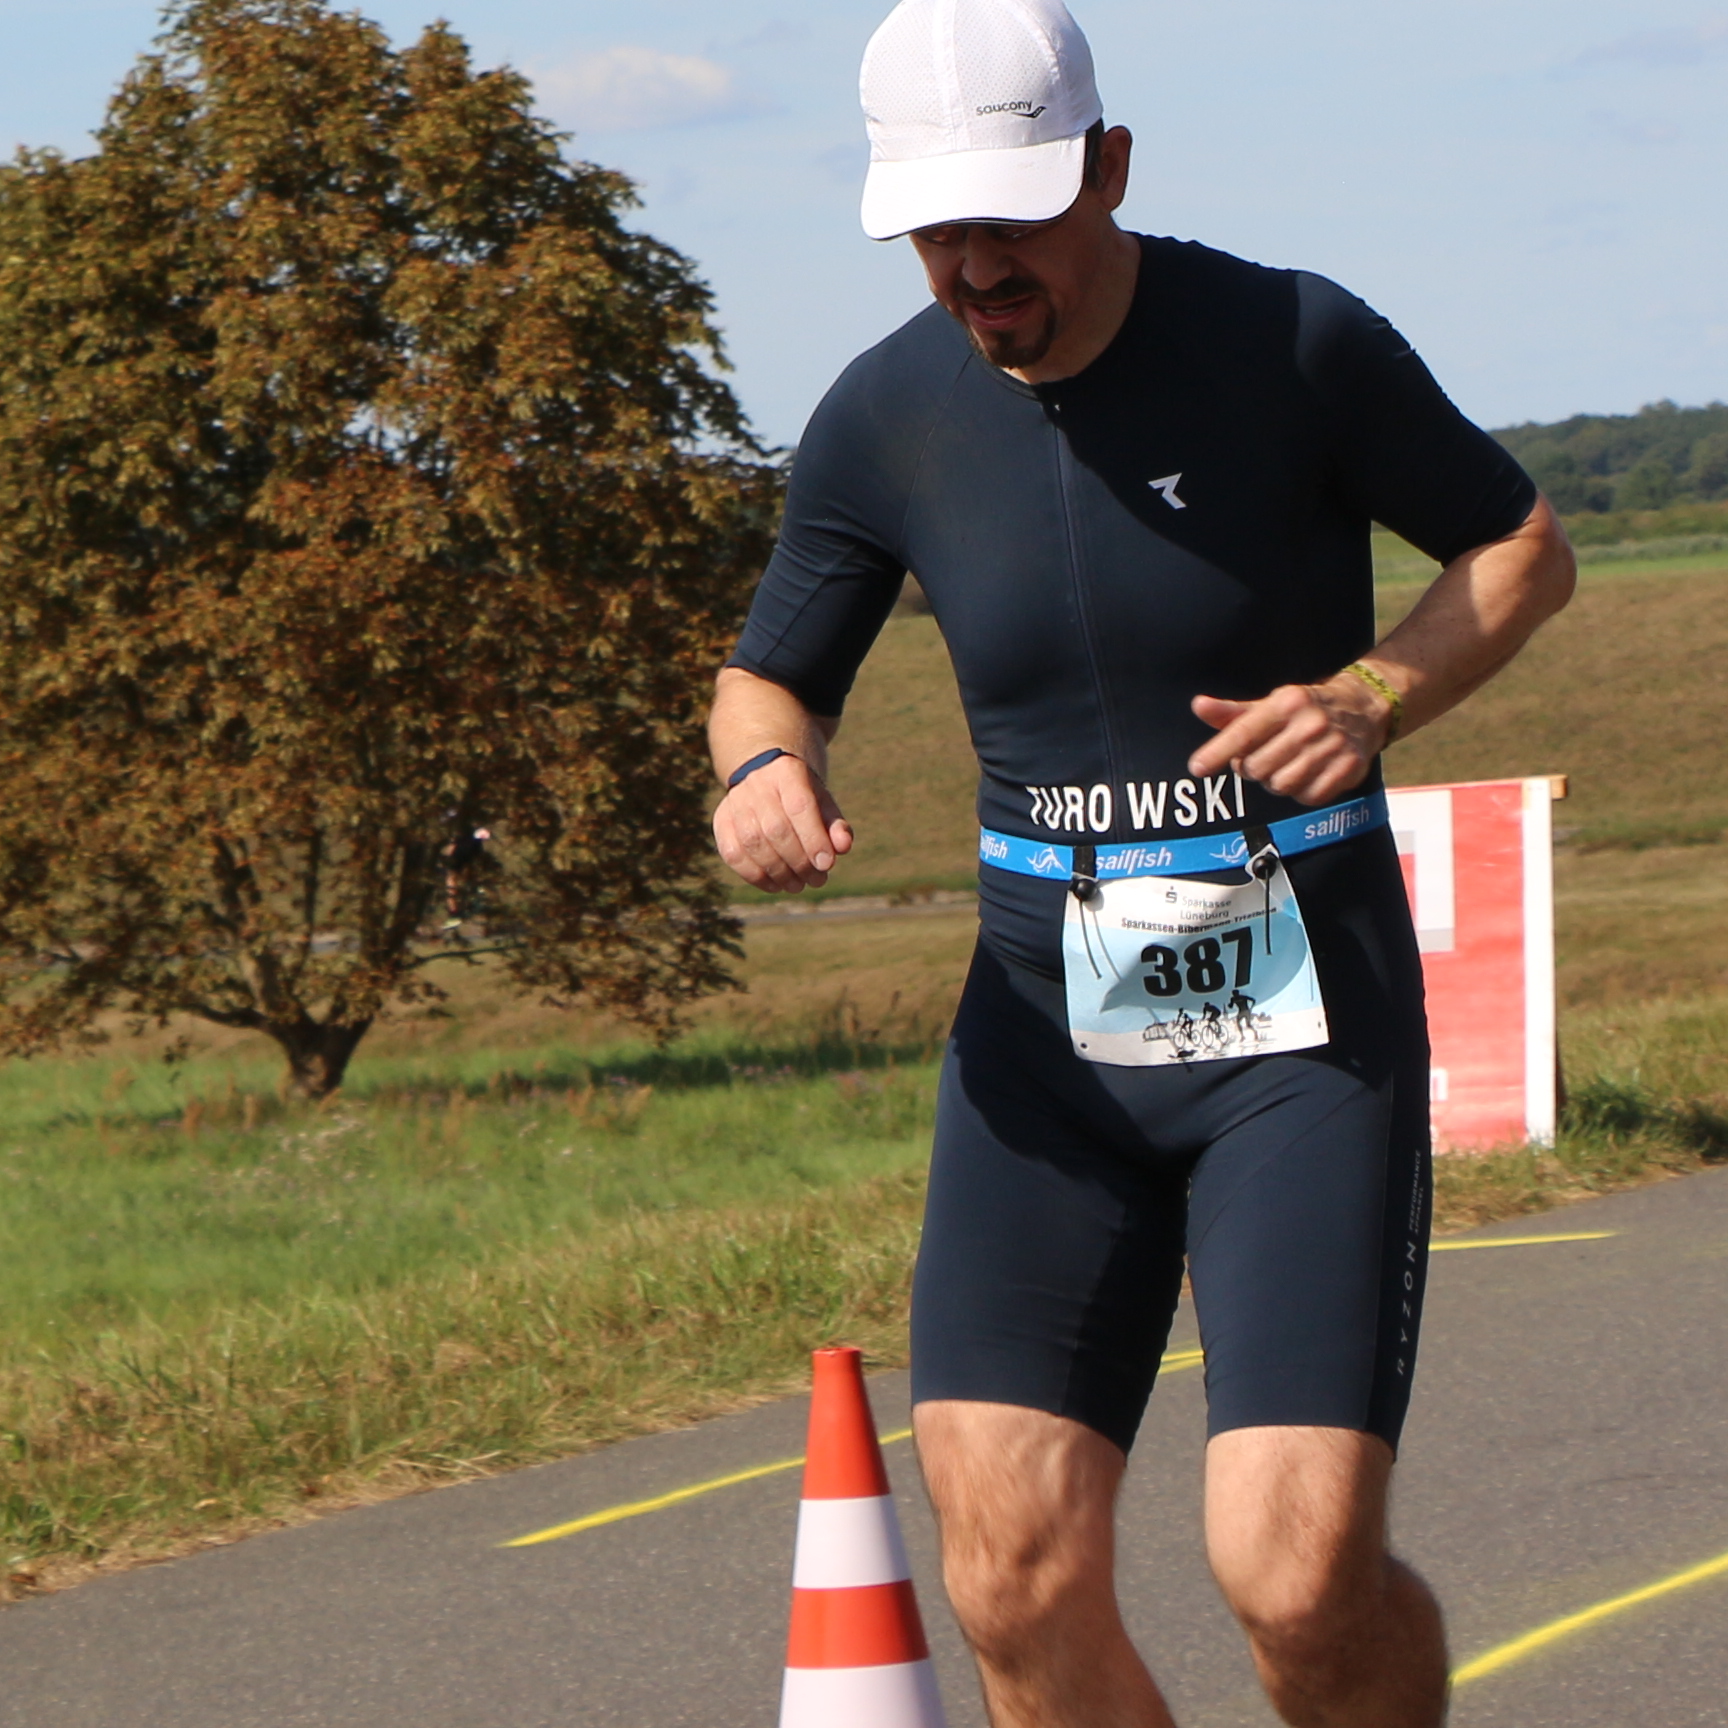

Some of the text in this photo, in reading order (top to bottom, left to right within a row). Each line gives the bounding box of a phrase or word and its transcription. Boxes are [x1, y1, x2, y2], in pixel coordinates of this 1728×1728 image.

[976, 99, 1033, 116] saucony
[1095, 846, 1173, 875] sailfish
[1304, 803, 1370, 840] sailfish
[1182, 896, 1232, 911] Sparkasse
[1180, 910, 1230, 922] Lüneburg
[1141, 926, 1253, 997] 387
